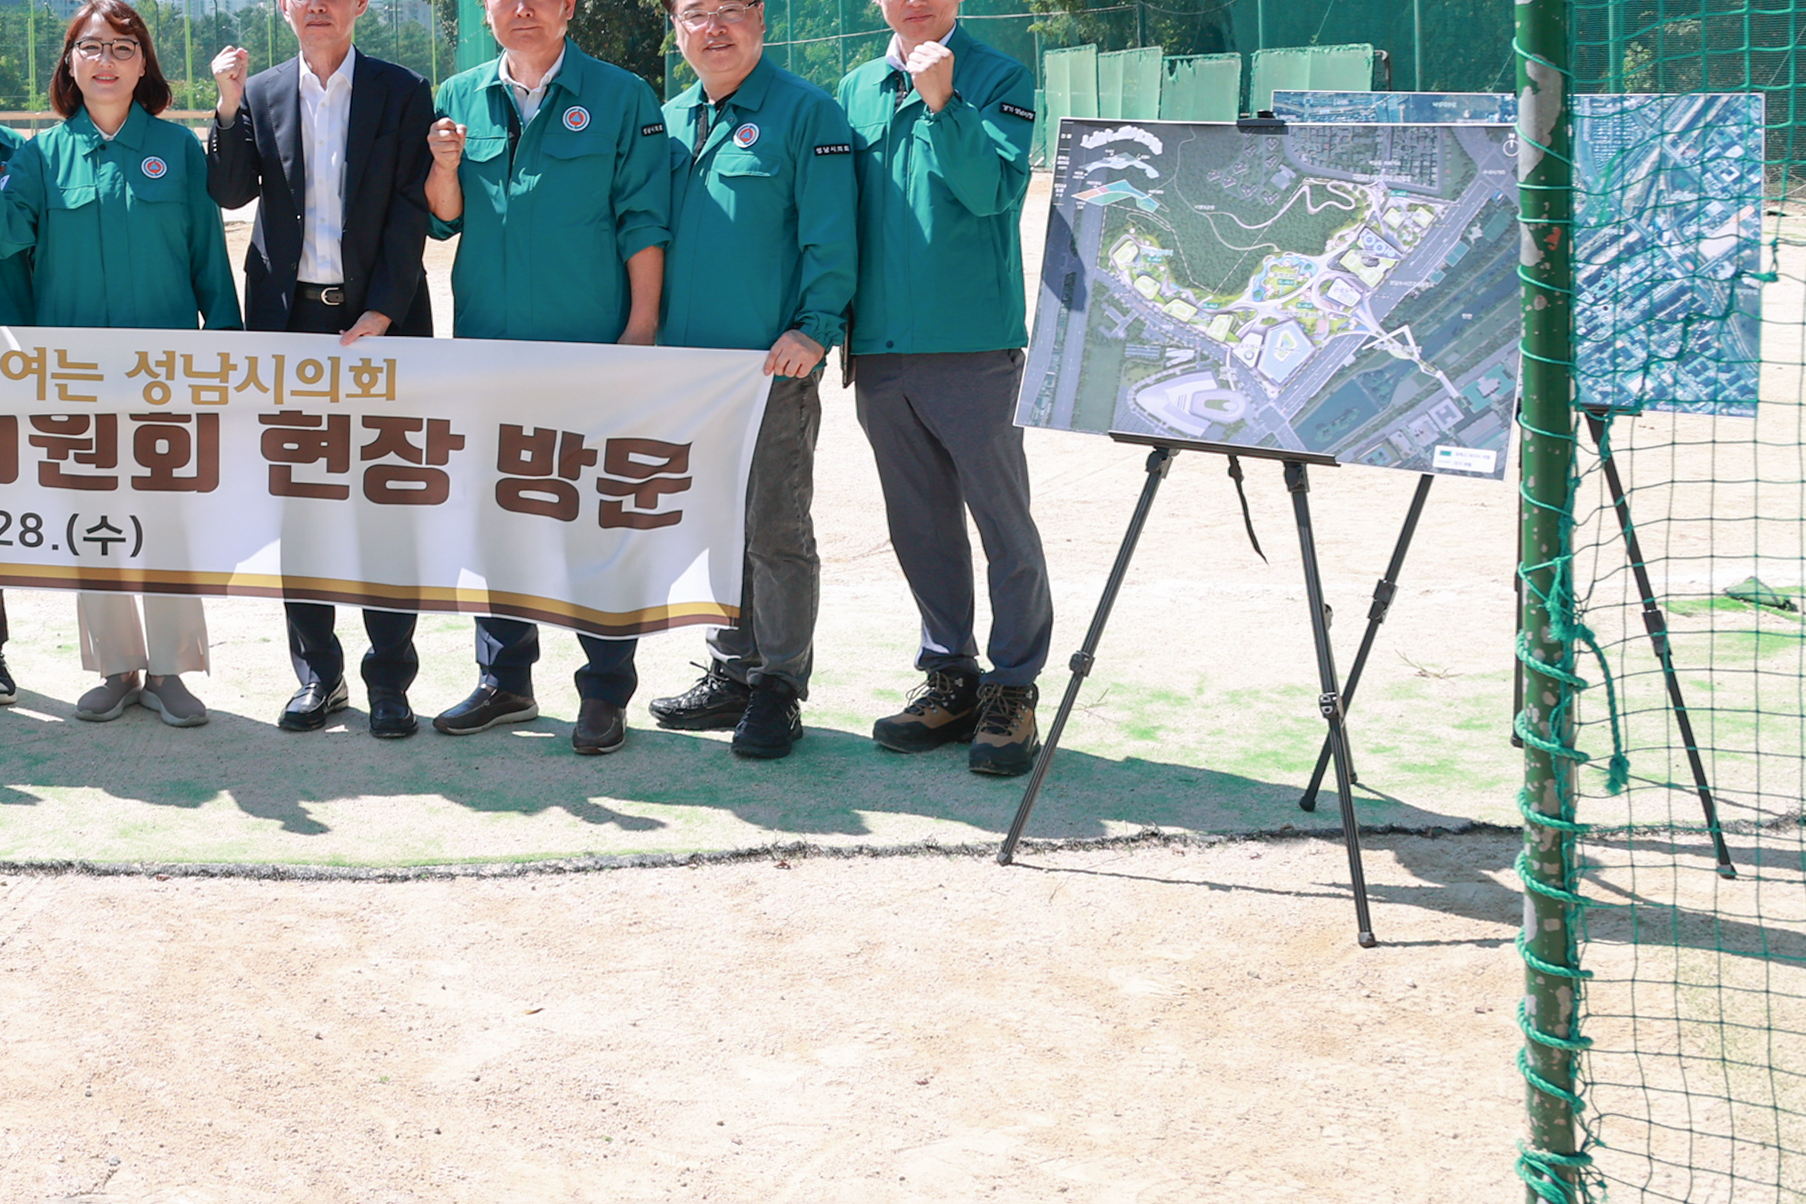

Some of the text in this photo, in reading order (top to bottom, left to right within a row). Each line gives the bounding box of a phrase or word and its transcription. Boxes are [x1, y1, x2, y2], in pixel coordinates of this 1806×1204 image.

[815, 145, 850, 155] 성남시의회
[0, 347, 104, 403] 여는
[125, 350, 397, 406] 성남시의회
[258, 410, 465, 506] 현장
[495, 423, 693, 530] 방문
